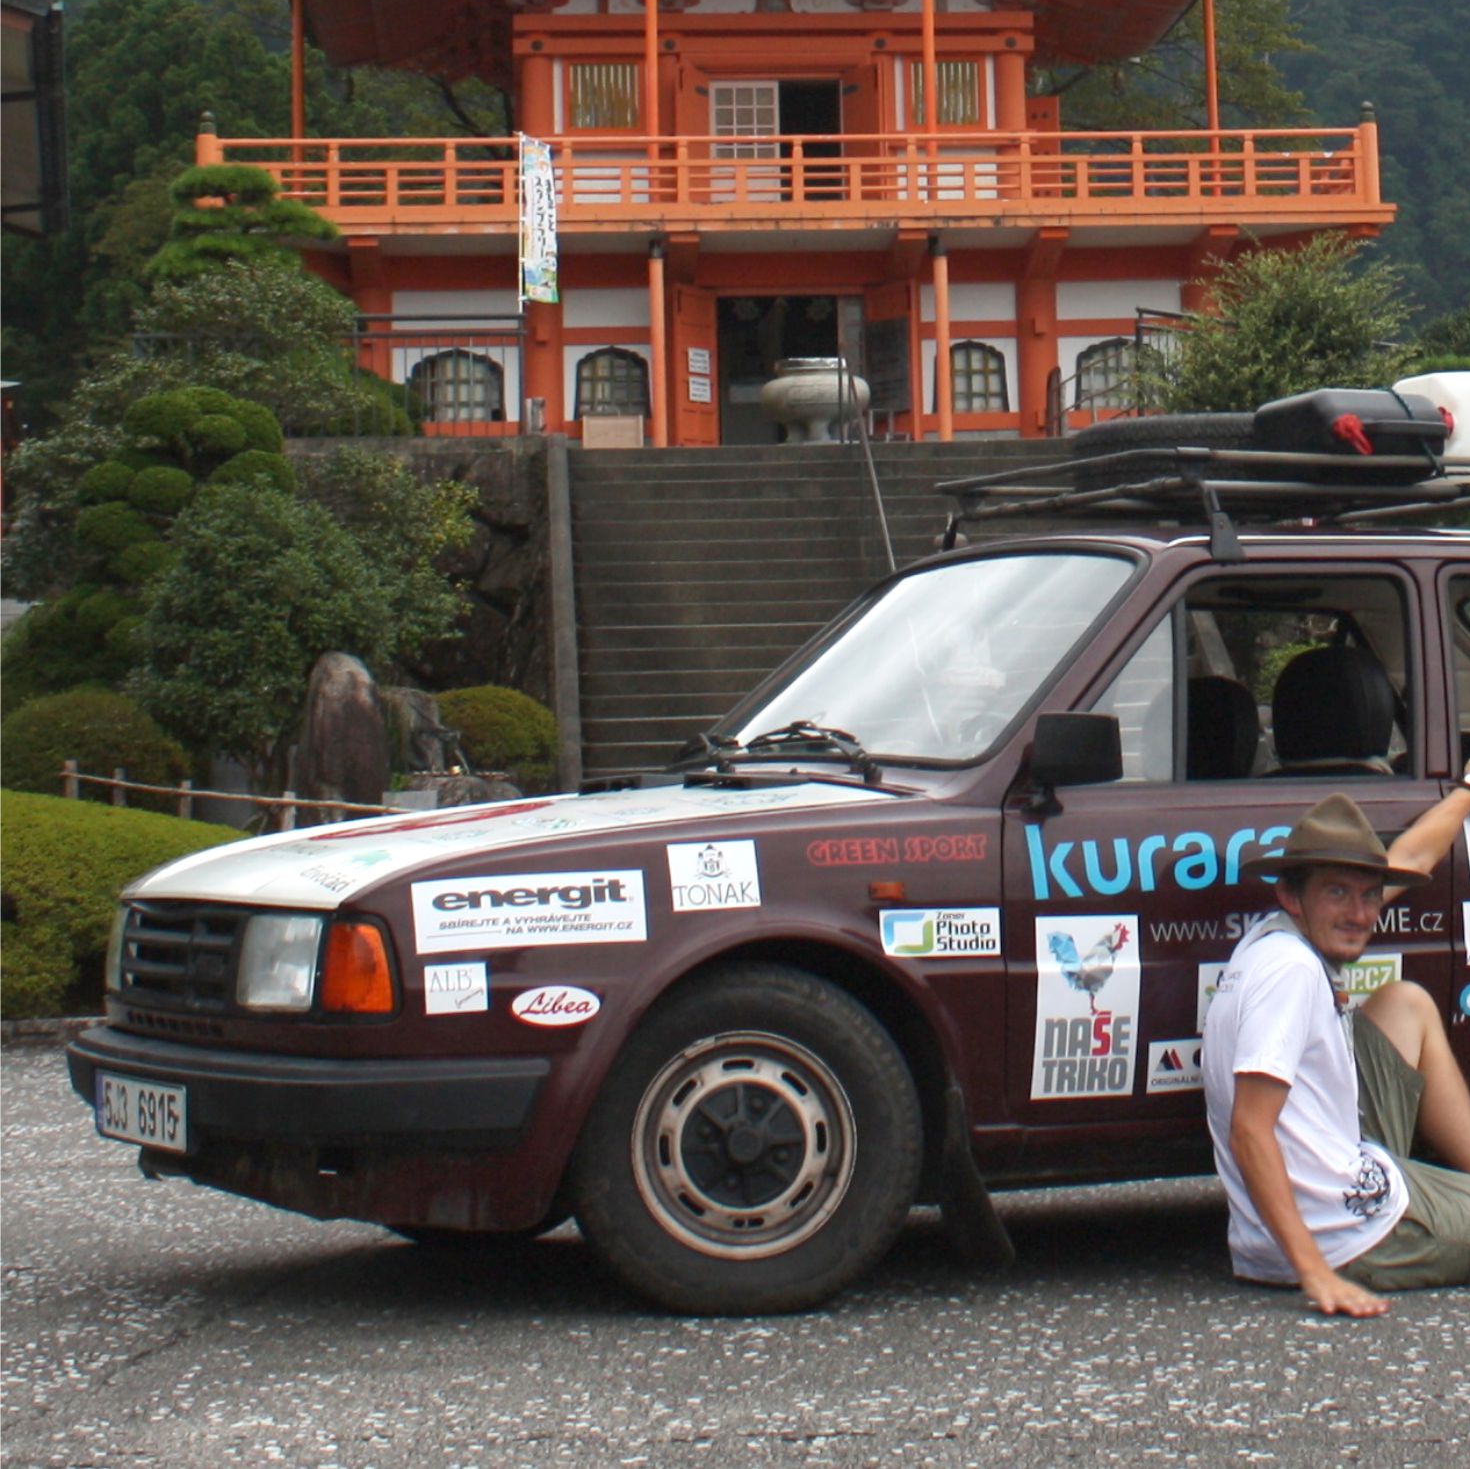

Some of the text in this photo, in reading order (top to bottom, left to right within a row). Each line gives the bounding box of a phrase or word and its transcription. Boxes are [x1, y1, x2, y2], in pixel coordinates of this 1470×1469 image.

[806, 834, 988, 867] GREEN SPORT
[431, 878, 628, 912] energit
[672, 881, 754, 908] TONAK
[438, 912, 592, 931] SBÍREJTE A VYHRÁVEJTE
[505, 921, 634, 936] NA WWW.ENERGIT.CZ
[936, 920, 992, 936] Photo
[936, 936, 997, 952] Studio
[519, 990, 594, 1017] Libea
[1042, 1056, 1128, 1094] TRIKO
[104, 1081, 180, 1142] 5J3 6915
